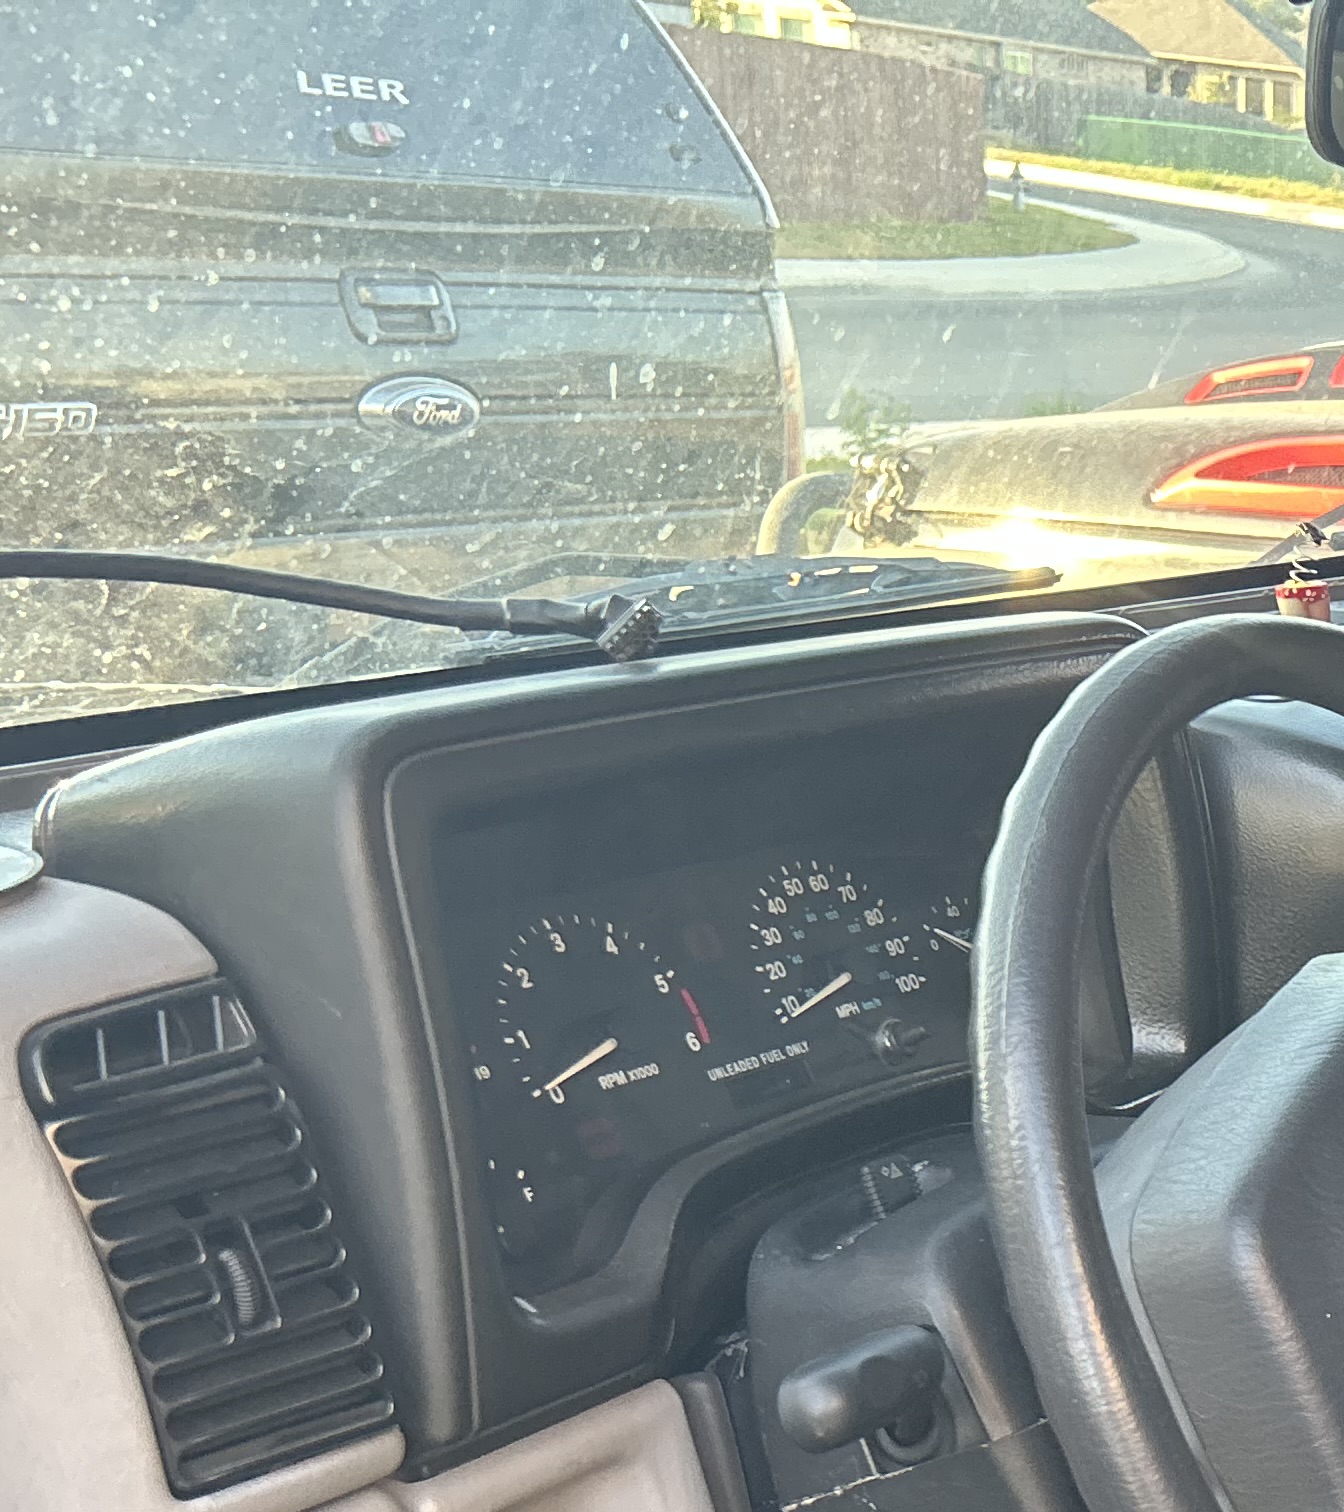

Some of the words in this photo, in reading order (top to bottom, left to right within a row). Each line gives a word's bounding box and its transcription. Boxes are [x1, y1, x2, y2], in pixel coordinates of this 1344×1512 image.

[297, 70, 409, 105] LEER
[412, 396, 463, 425] Ford
[783, 878, 804, 897] 50
[809, 874, 829, 892] 60
[837, 885, 857, 903] 70
[768, 897, 787, 915] 40
[947, 905, 960, 917] 40
[864, 908, 884, 926] 80
[550, 933, 566, 953] 3
[606, 936, 619, 955] 4
[760, 927, 782, 946] 30
[930, 940, 939, 951] 0
[885, 938, 905, 957] 90
[516, 967, 534, 989] 2
[766, 961, 787, 980] 20
[654, 974, 670, 993] 5
[895, 974, 920, 993] 100
[781, 995, 803, 1014] 10
[835, 1001, 861, 1019] MPH
[517, 1030, 531, 1049] 1
[685, 1031, 701, 1052] 6
[707, 1056, 760, 1082] UNLEADED
[761, 1049, 787, 1066] FUEL
[785, 1040, 810, 1057] ONLY
[473, 1065, 491, 1081] 19
[598, 1070, 628, 1090] RPM
[550, 1086, 565, 1104] 0
[522, 1187, 534, 1203] F
